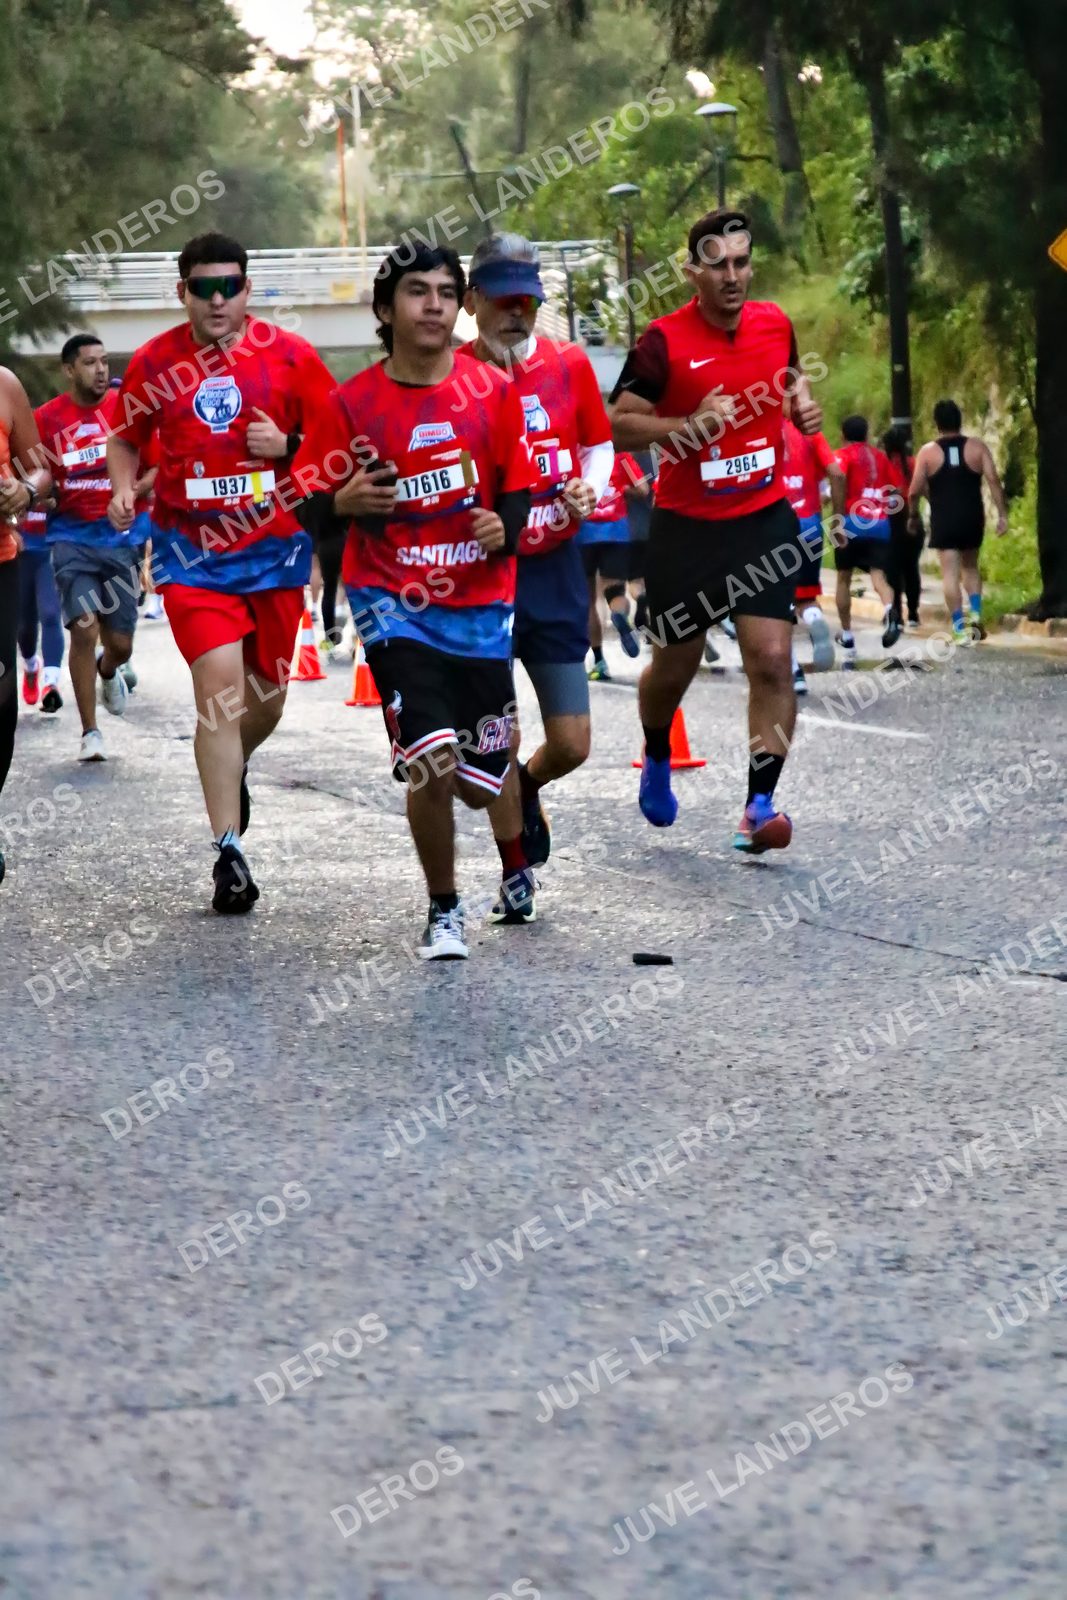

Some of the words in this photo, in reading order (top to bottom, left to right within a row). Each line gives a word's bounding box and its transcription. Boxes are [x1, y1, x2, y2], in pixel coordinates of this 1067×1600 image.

[725, 454, 758, 475] 2964
[211, 476, 247, 496] 1937
[402, 468, 451, 498] 17616
